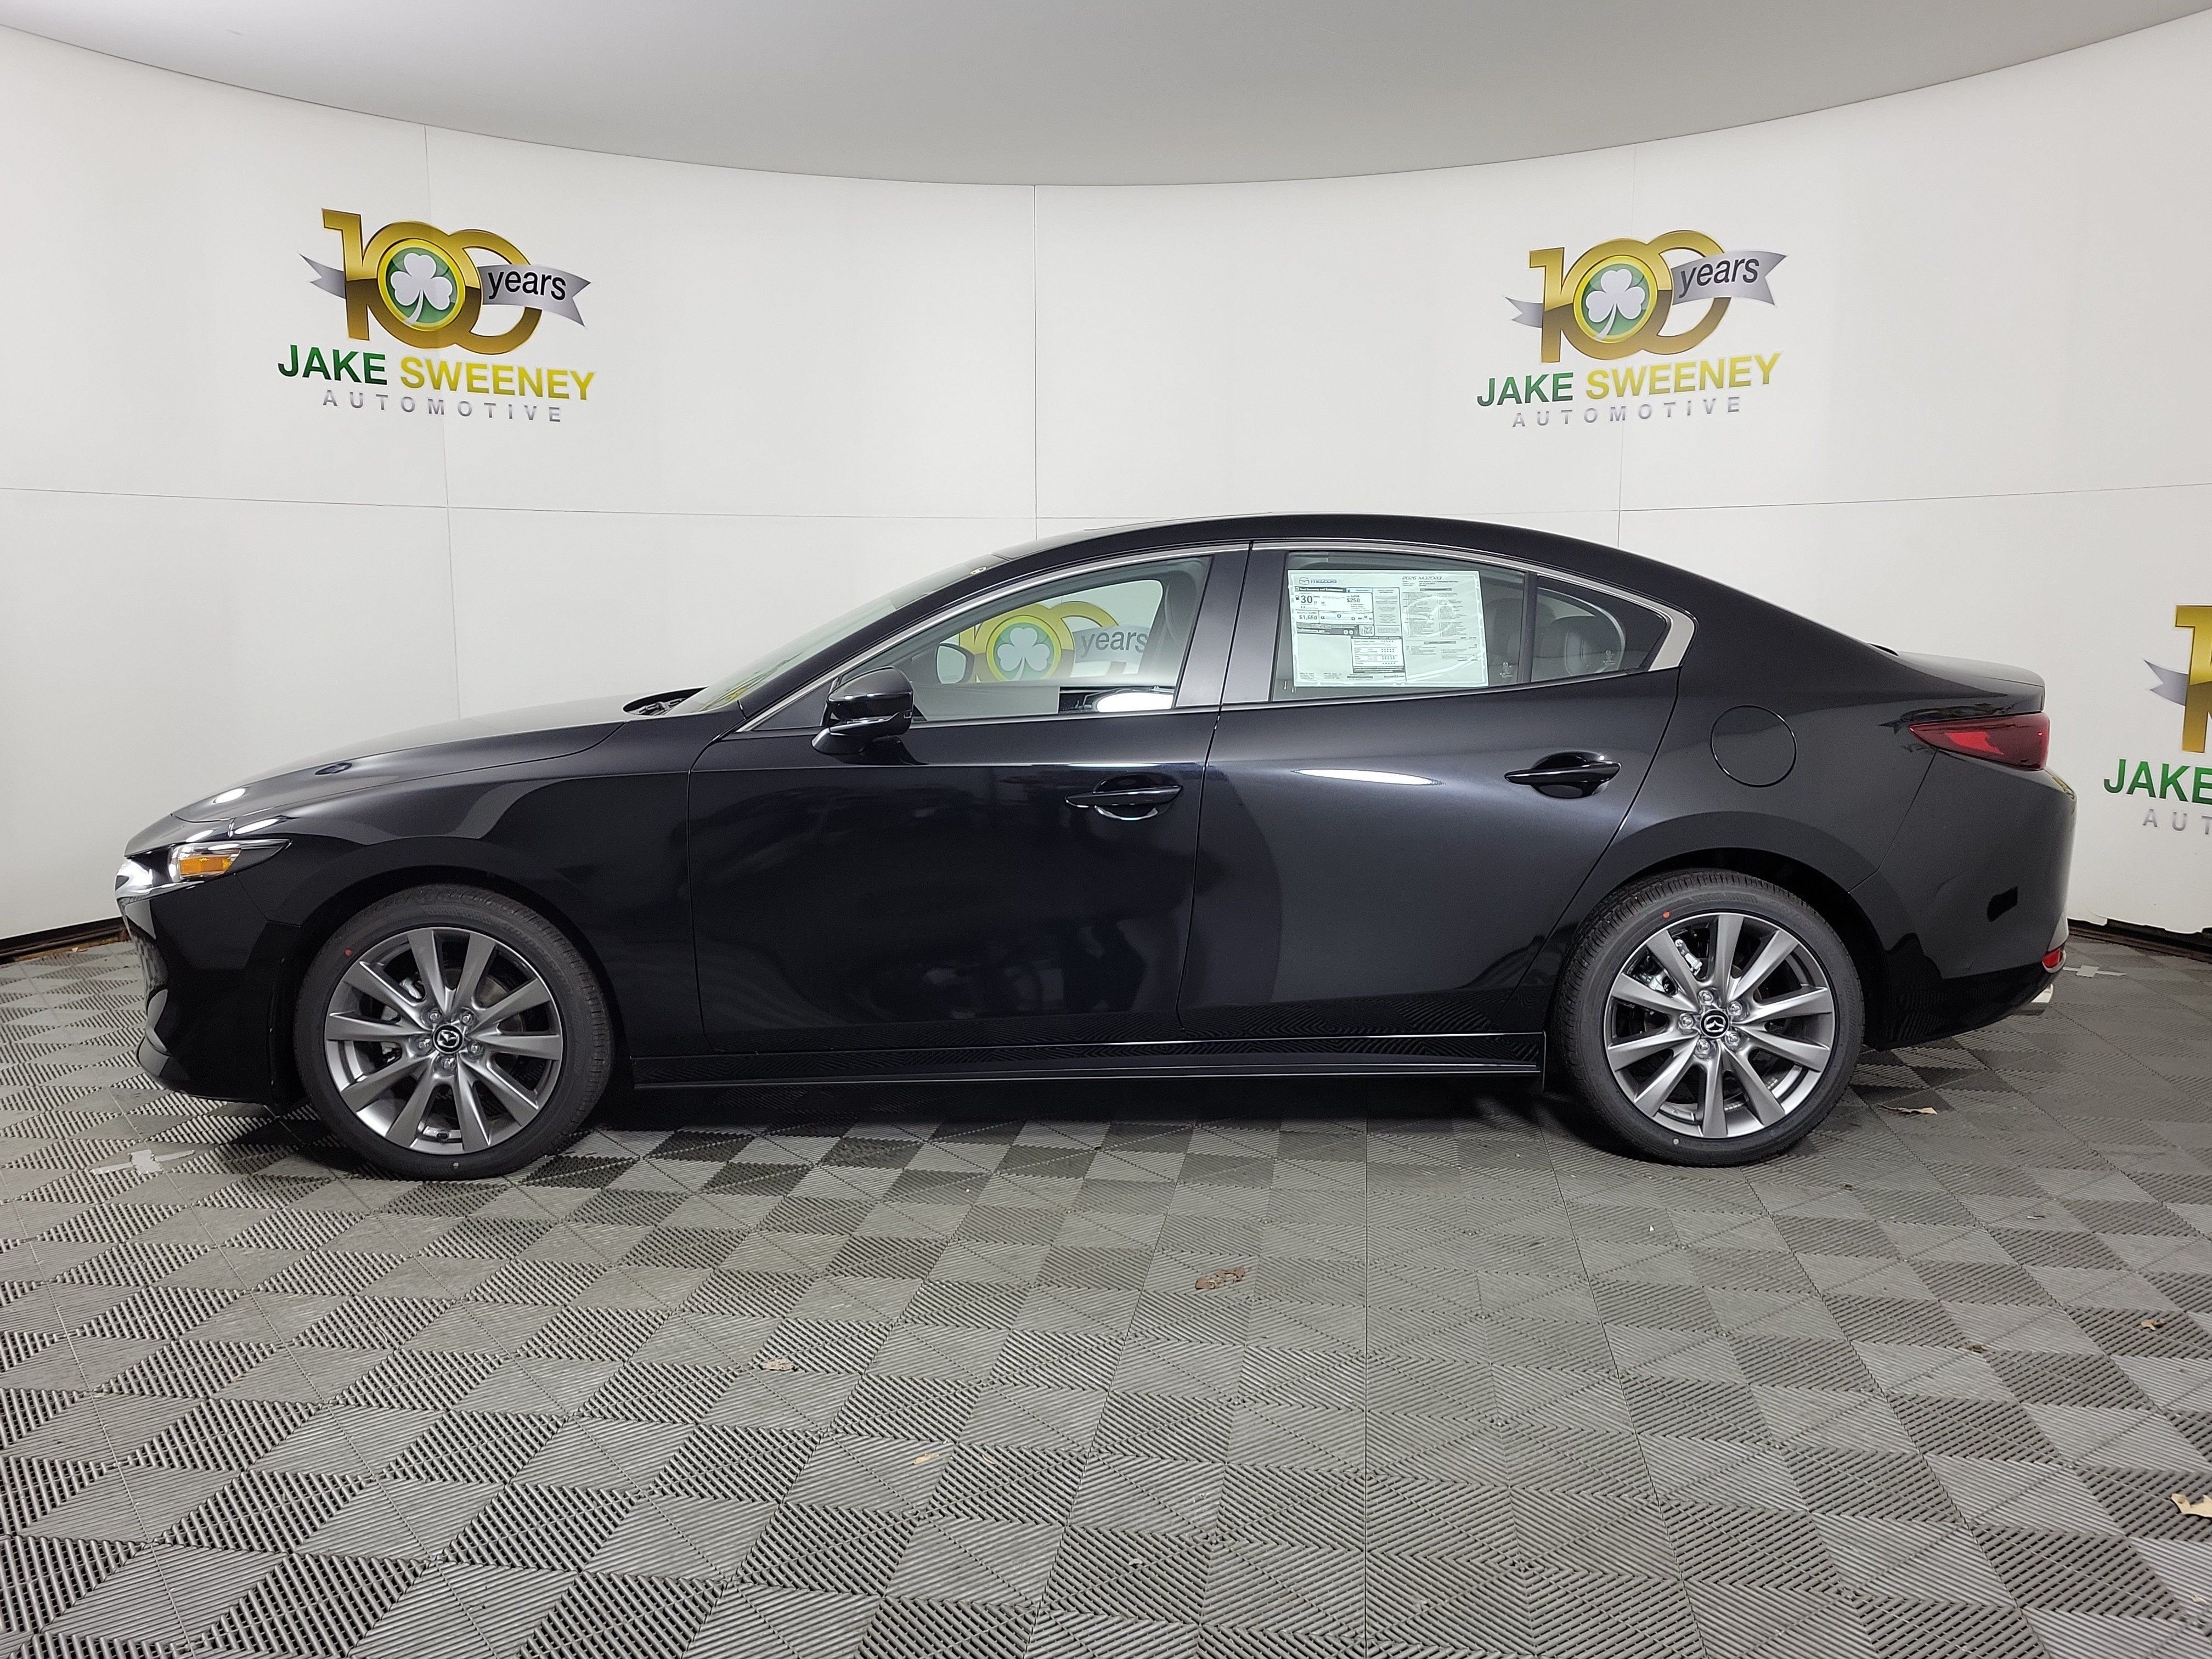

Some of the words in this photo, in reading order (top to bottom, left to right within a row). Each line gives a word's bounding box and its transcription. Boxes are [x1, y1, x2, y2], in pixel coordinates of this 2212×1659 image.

[488, 271, 566, 301] years
[1679, 256, 1760, 297] years
[278, 345, 388, 386] JAKE
[400, 357, 595, 400] SWEENEY
[1477, 373, 1573, 407] JAKE
[1585, 353, 1780, 399] SWEENEY
[323, 390, 561, 422] AUTOMOTIVE
[1512, 396, 1740, 427] AUTOMOTIVE
[1301, 595, 1312, 603] 30
[1081, 631, 1147, 658] years
[2103, 759, 2212, 804] JAKE
